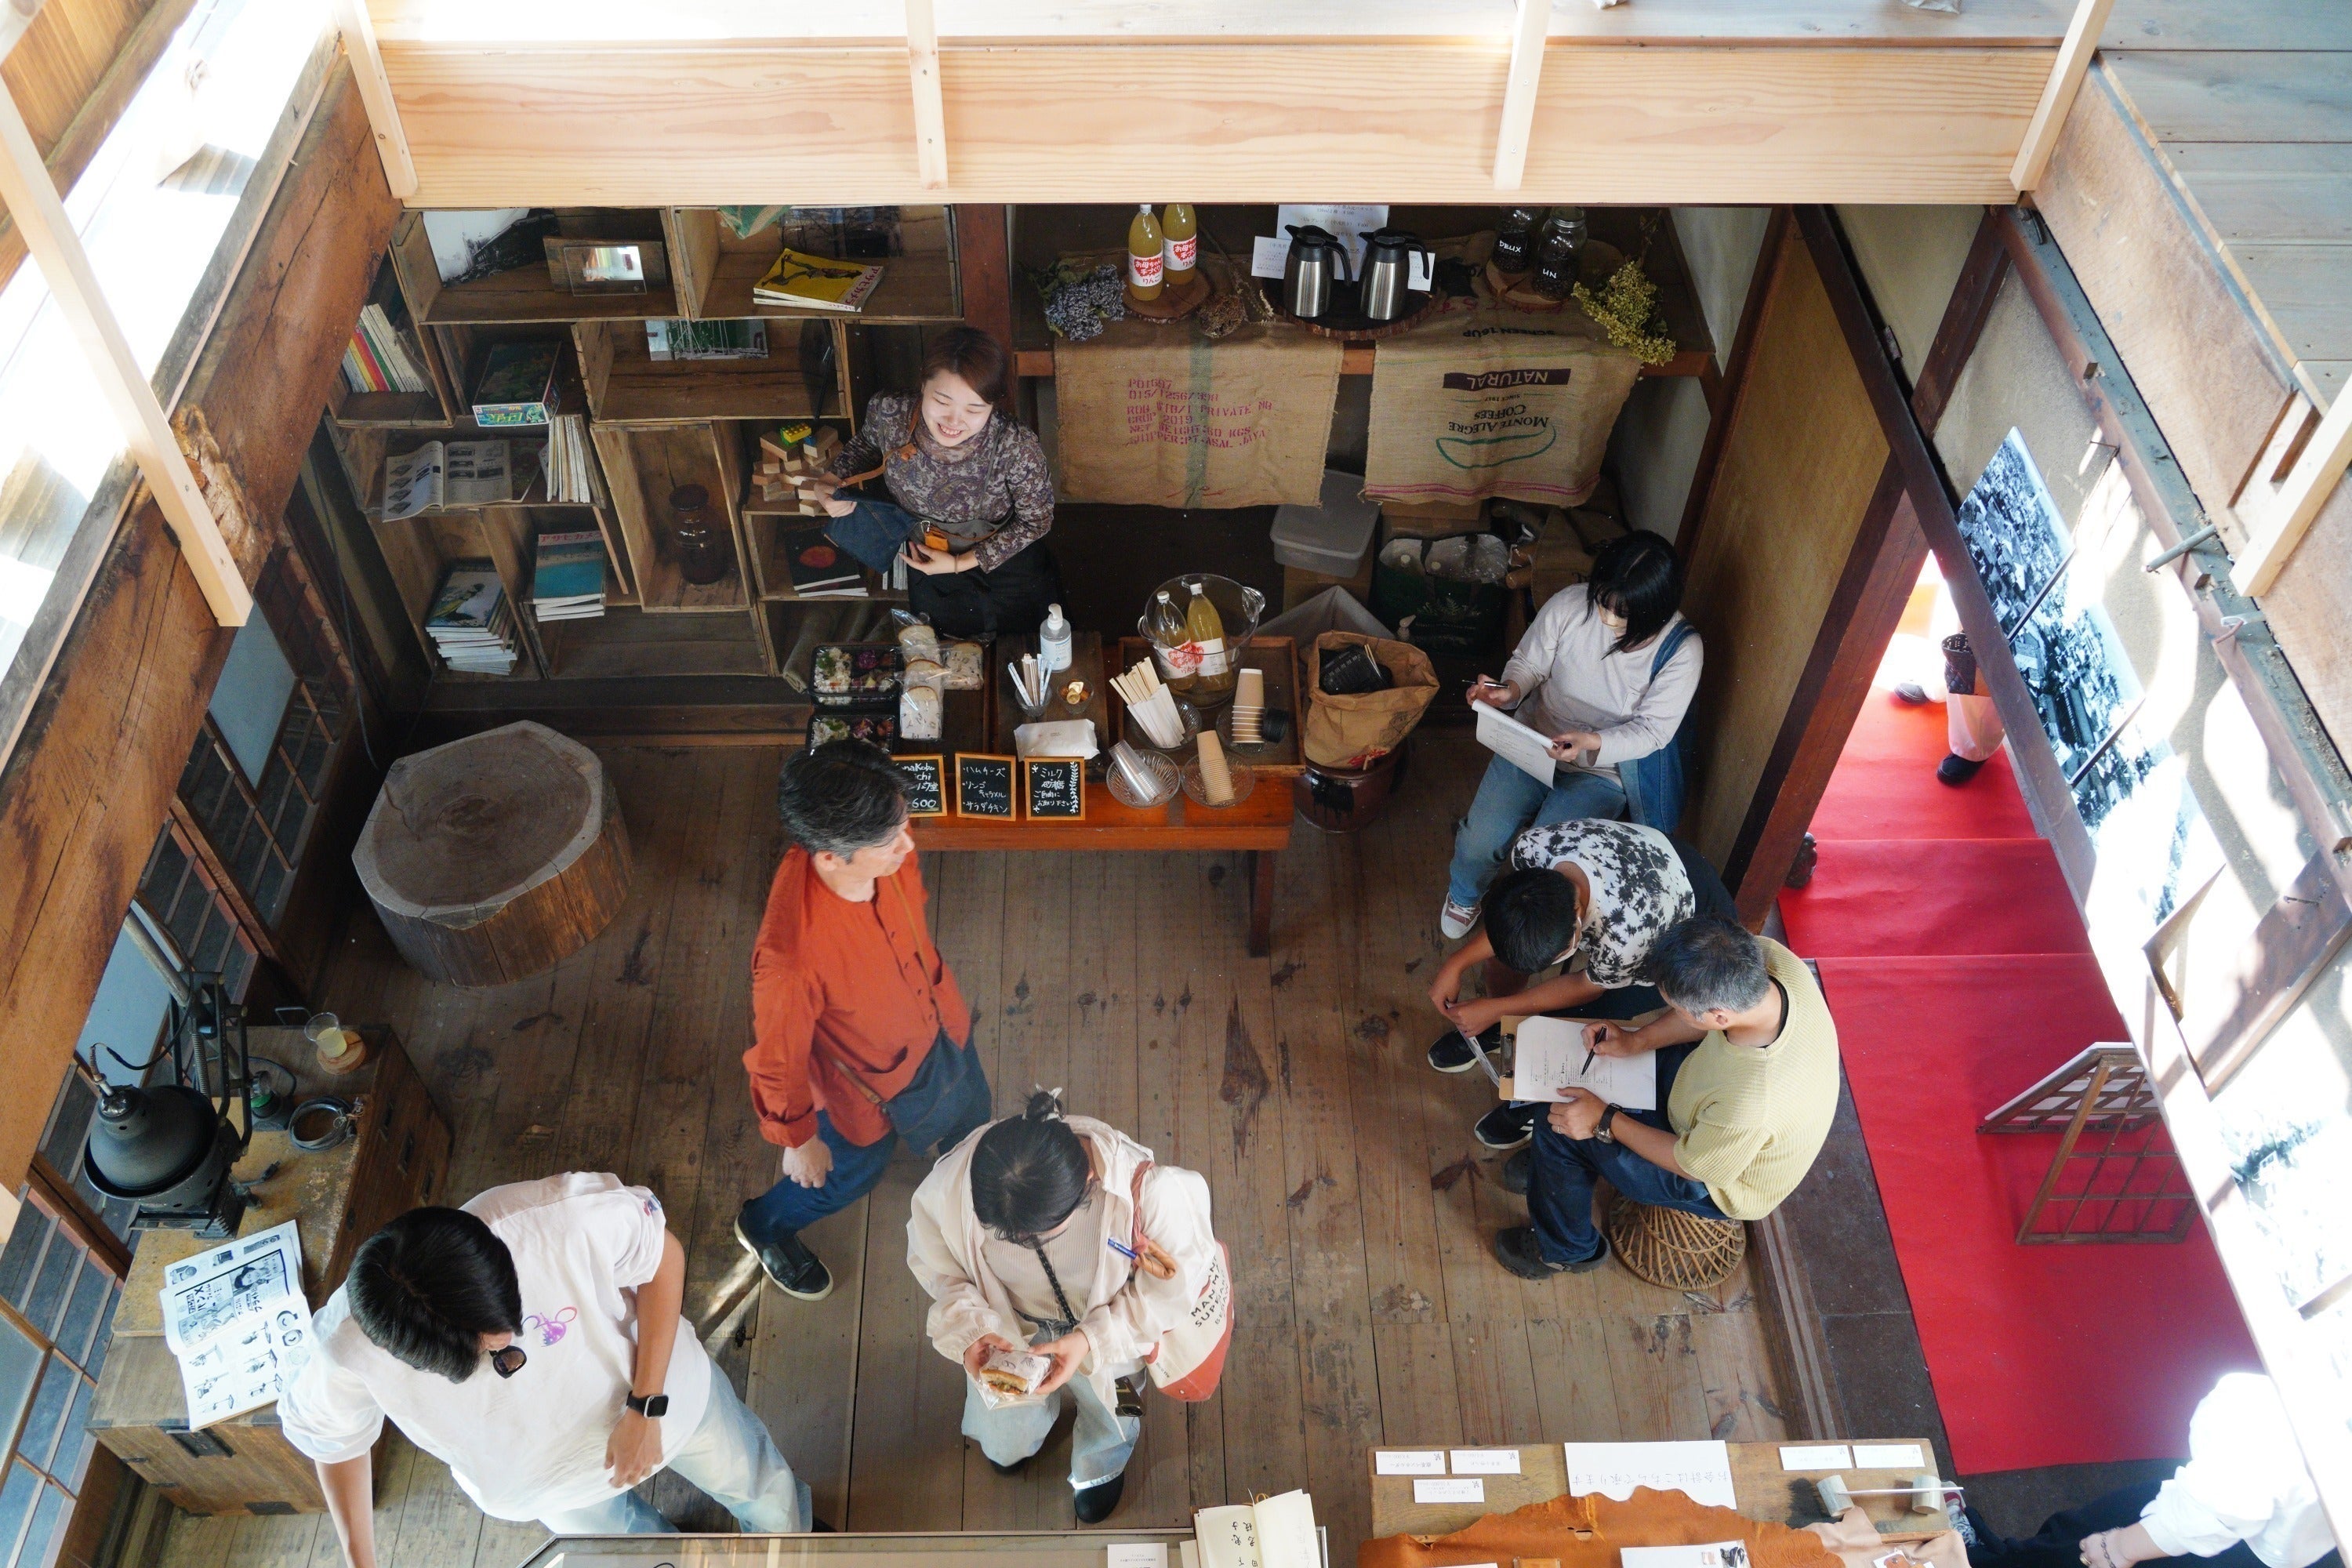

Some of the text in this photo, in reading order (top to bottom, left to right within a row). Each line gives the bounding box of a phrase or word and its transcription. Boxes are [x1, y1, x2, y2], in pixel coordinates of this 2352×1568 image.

[1499, 240, 1521, 252] DEUX
[1543, 268, 1557, 279] UN
[1467, 371, 1548, 389] NATURAL
[1200, 405, 1252, 417] PRIVATE
[1474, 404, 1526, 420] COFFEES
[1163, 415, 1193, 425] 2019
[1448, 417, 1550, 434] MONTE ALEGRE
[1040, 768, 1062, 779] ミルク
[978, 789, 1006, 798] キャラメル
